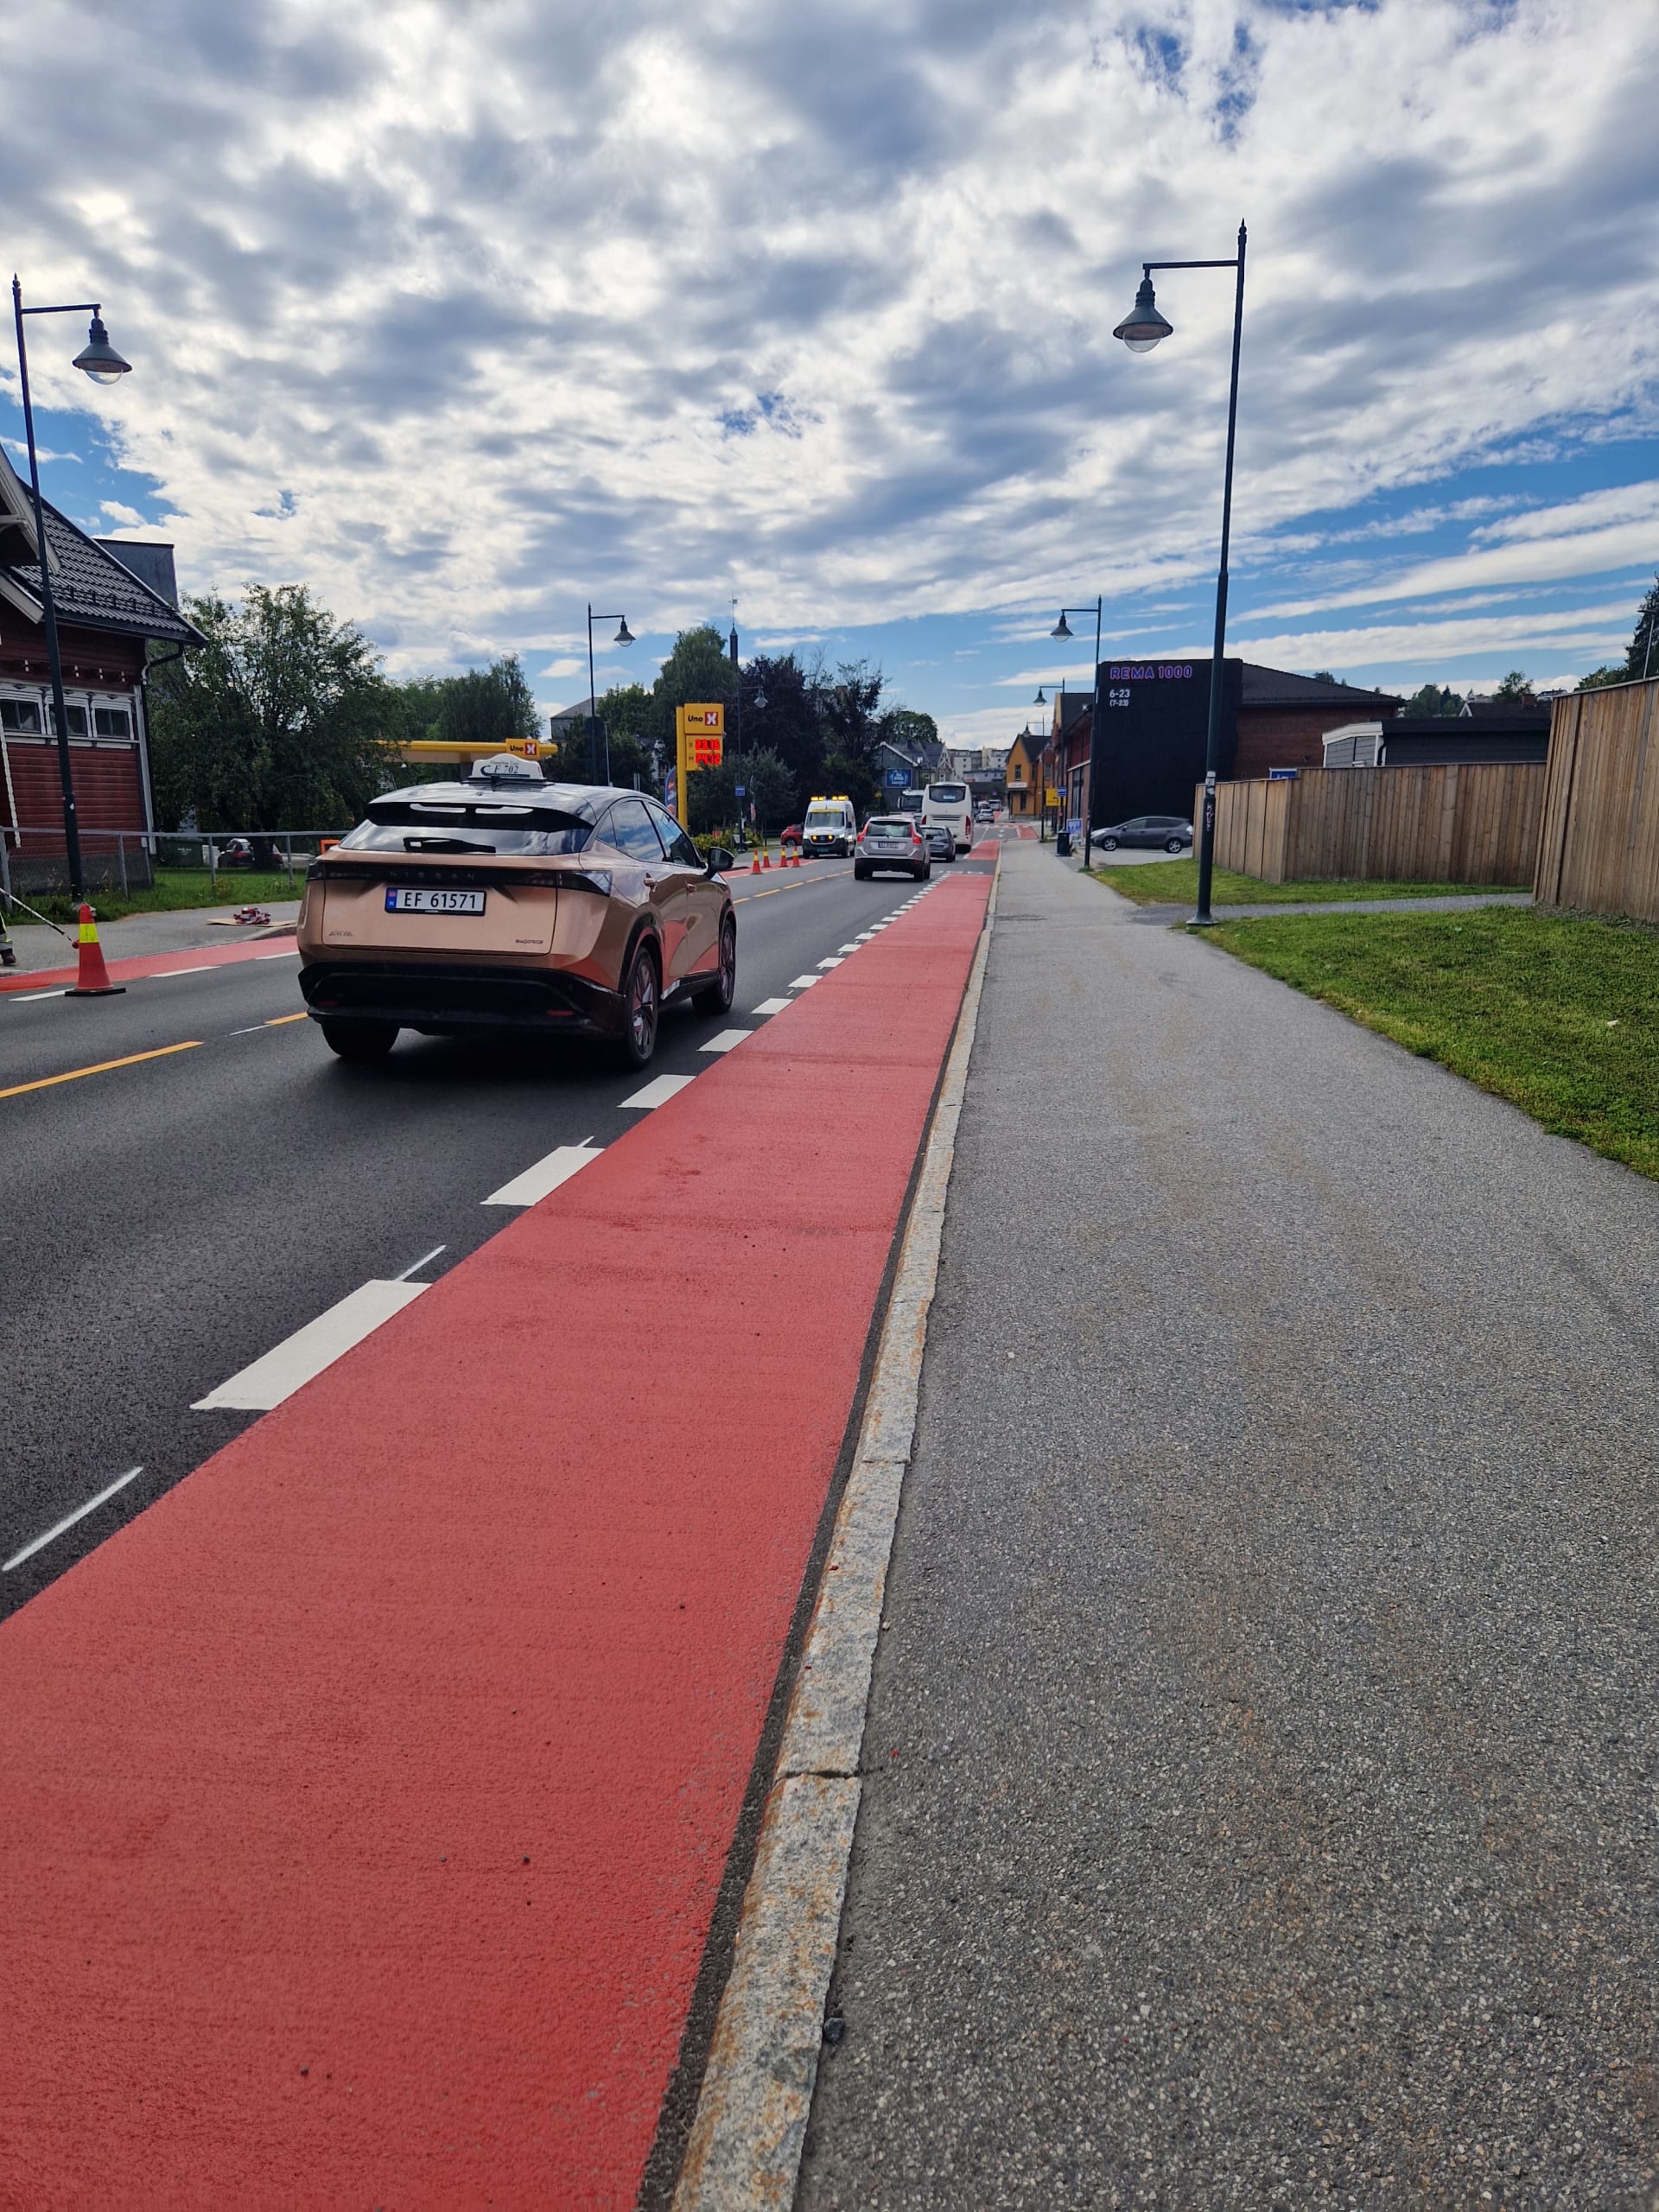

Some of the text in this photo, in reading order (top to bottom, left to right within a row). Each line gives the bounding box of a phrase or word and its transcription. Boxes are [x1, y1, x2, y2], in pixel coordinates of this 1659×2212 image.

[1110, 665, 1192, 679] REMA 1000
[1109, 689, 1130, 698] 6-23
[504, 765, 518, 773] 702
[404, 892, 477, 909] EF 61571
